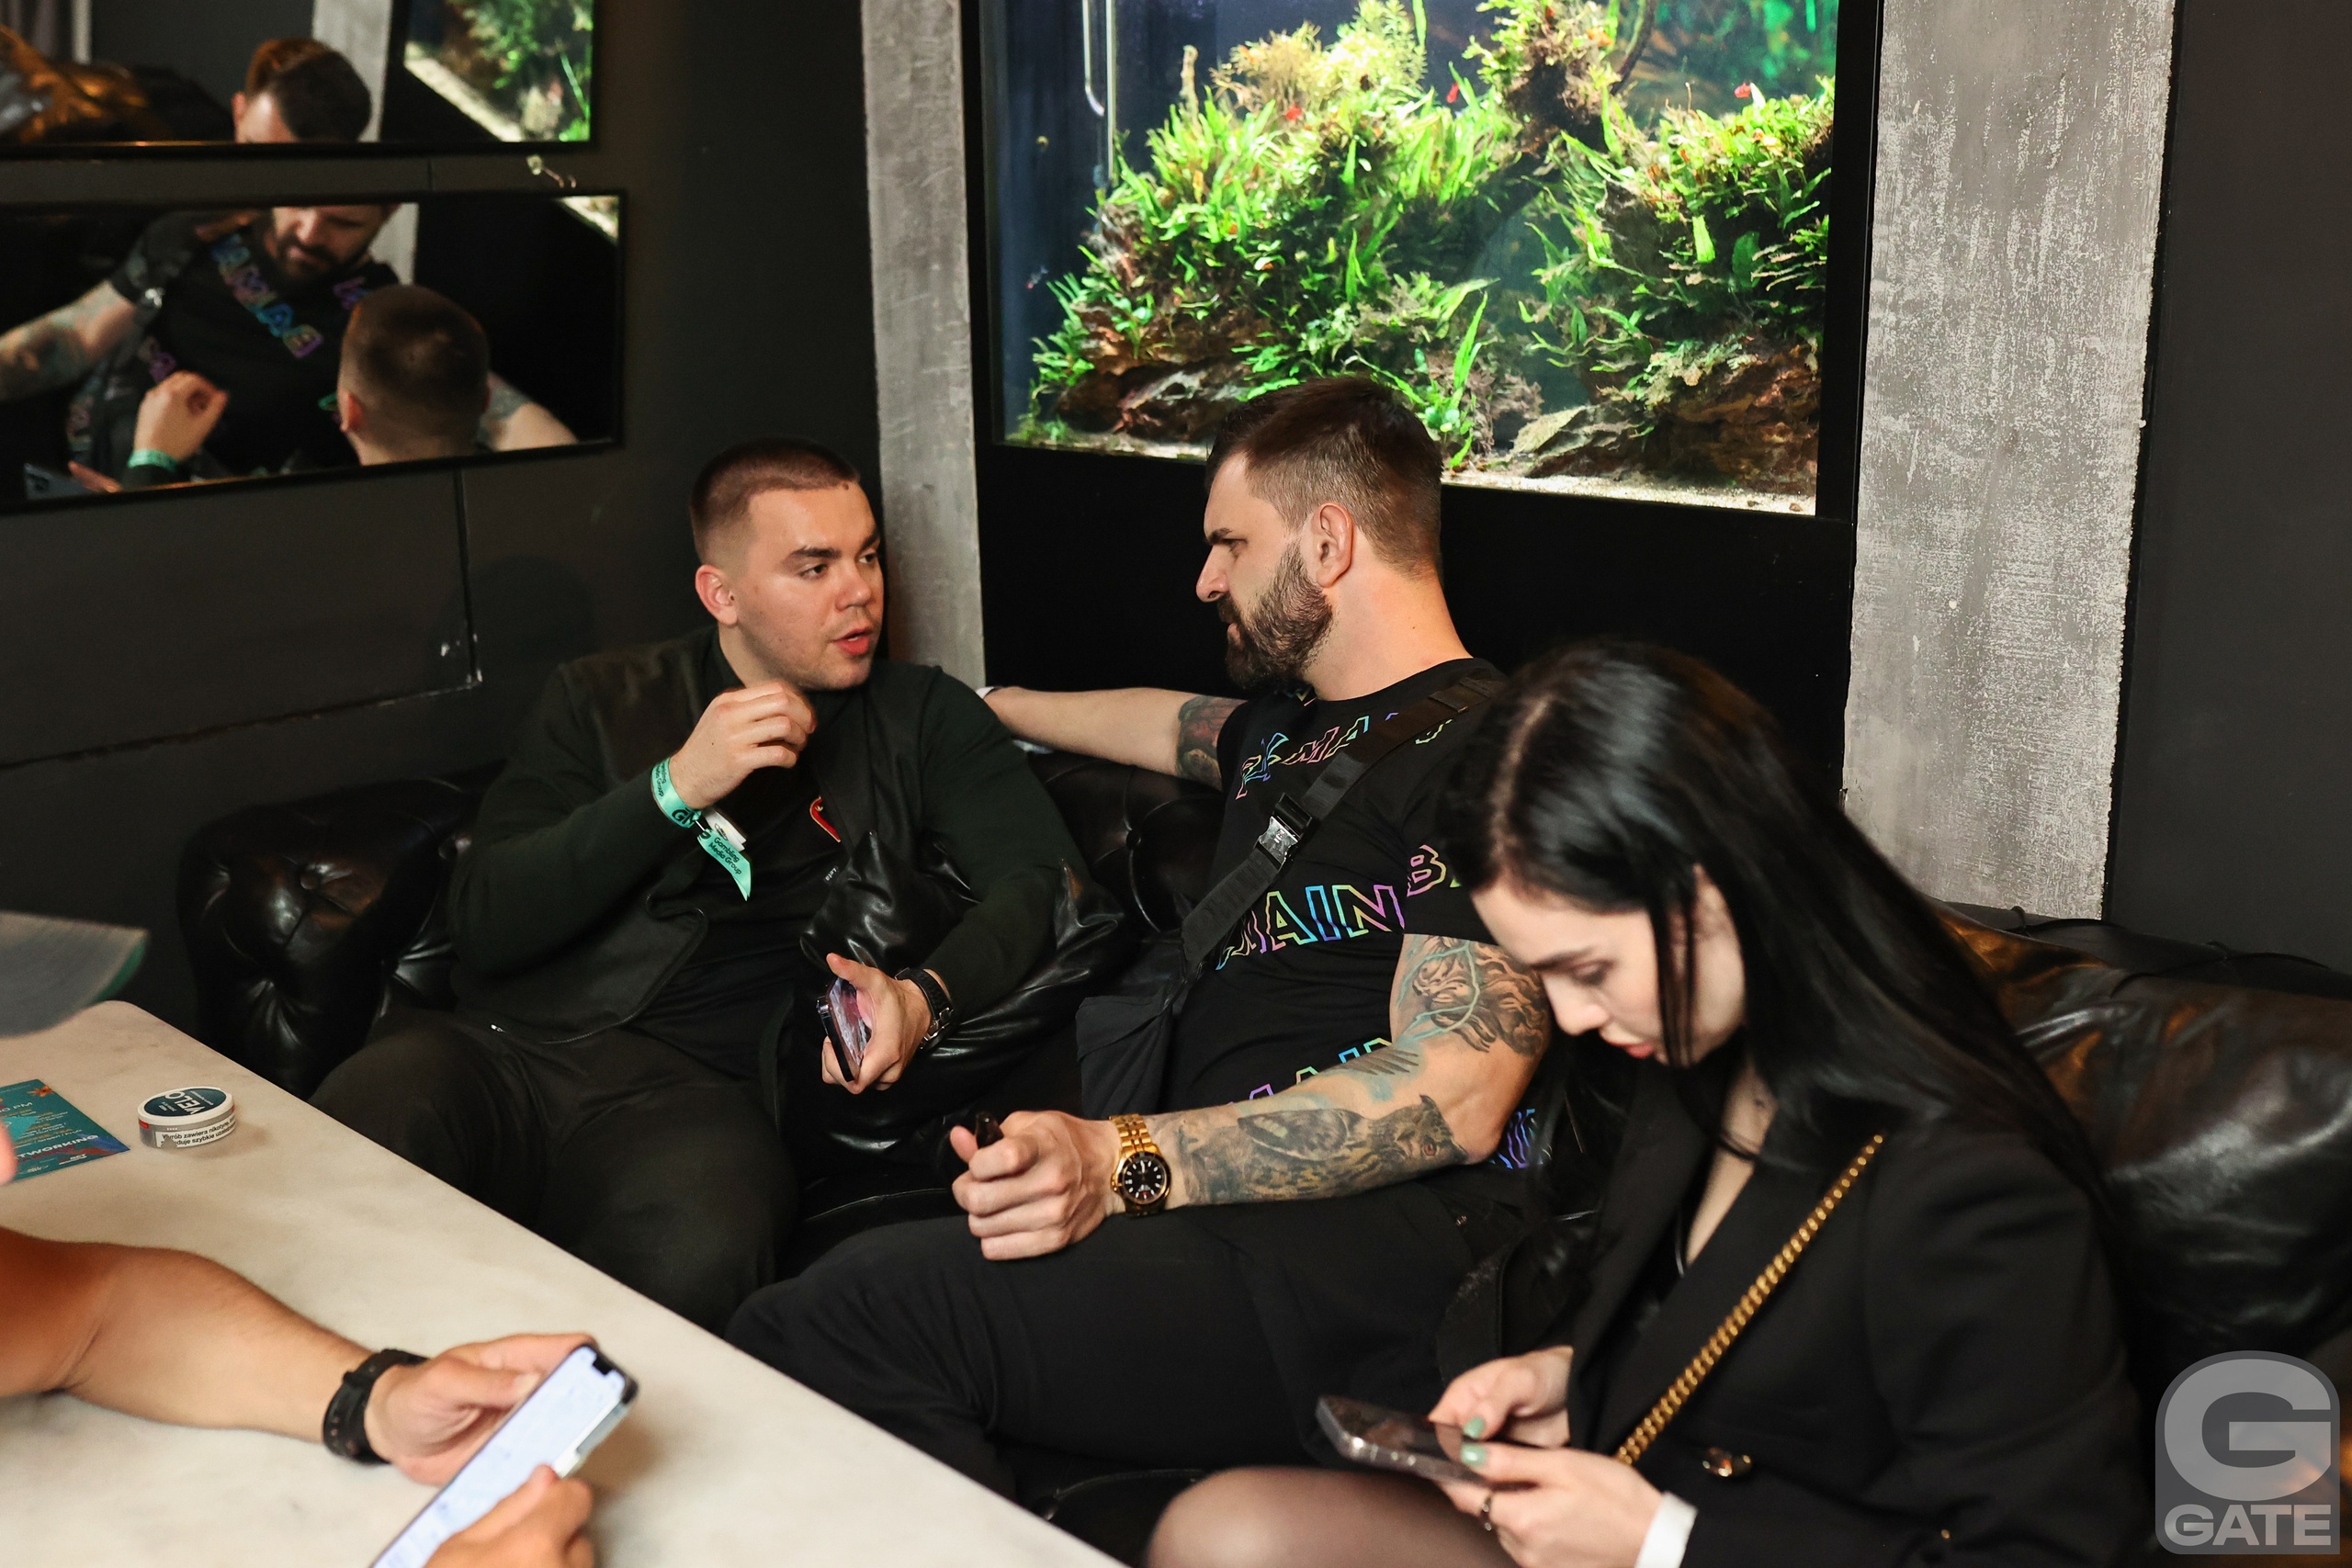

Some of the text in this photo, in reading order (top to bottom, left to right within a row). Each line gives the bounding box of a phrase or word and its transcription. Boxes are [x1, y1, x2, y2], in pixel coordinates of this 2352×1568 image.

[708, 841, 742, 875] Media Group
[714, 837, 740, 863] Gambling
[164, 1090, 206, 1115] VELO
[17, 1134, 98, 1158] TWORKING
[184, 1130, 208, 1139] zawiera
[192, 1134, 214, 1144] szybkie
